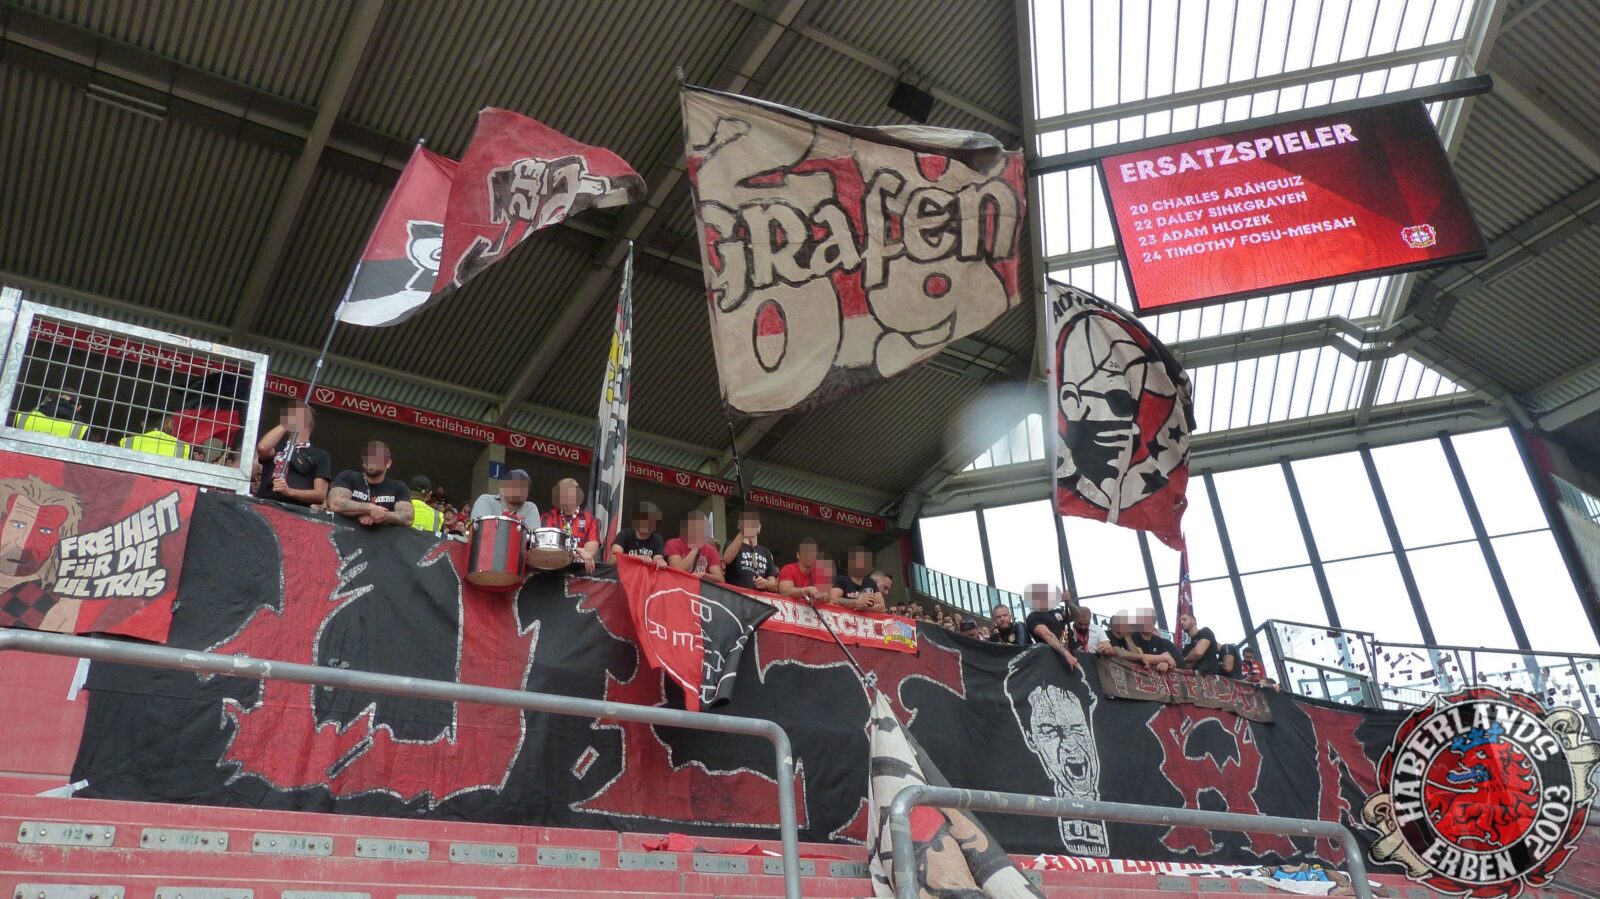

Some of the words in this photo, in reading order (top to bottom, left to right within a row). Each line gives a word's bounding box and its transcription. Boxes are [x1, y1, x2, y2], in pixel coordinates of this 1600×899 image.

[1119, 122, 1359, 185] ERSATZSPIELER
[1129, 203, 1148, 217] 20
[1151, 189, 1220, 213] CHARLES
[1223, 174, 1304, 200] ARÁNGUIZ
[1133, 219, 1153, 232] 22
[1156, 209, 1205, 229] DALEY
[1208, 190, 1308, 219] SINKGRAVEN
[1138, 233, 1158, 247] 23
[1162, 224, 1209, 246] ADAM
[1212, 213, 1274, 237] HLOZEK
[1142, 250, 1162, 264] 24
[1165, 235, 1236, 260] TIMOTHY
[1240, 215, 1357, 247] FOSU-MENSAH
[412, 411, 495, 443] Textilsharing
[750, 489, 809, 514] Textilsharing
[60, 491, 179, 559] FREIHEIT
[117, 538, 159, 572] DIE
[53, 568, 166, 598] ULTRAS
[62, 828, 83, 841] 02
